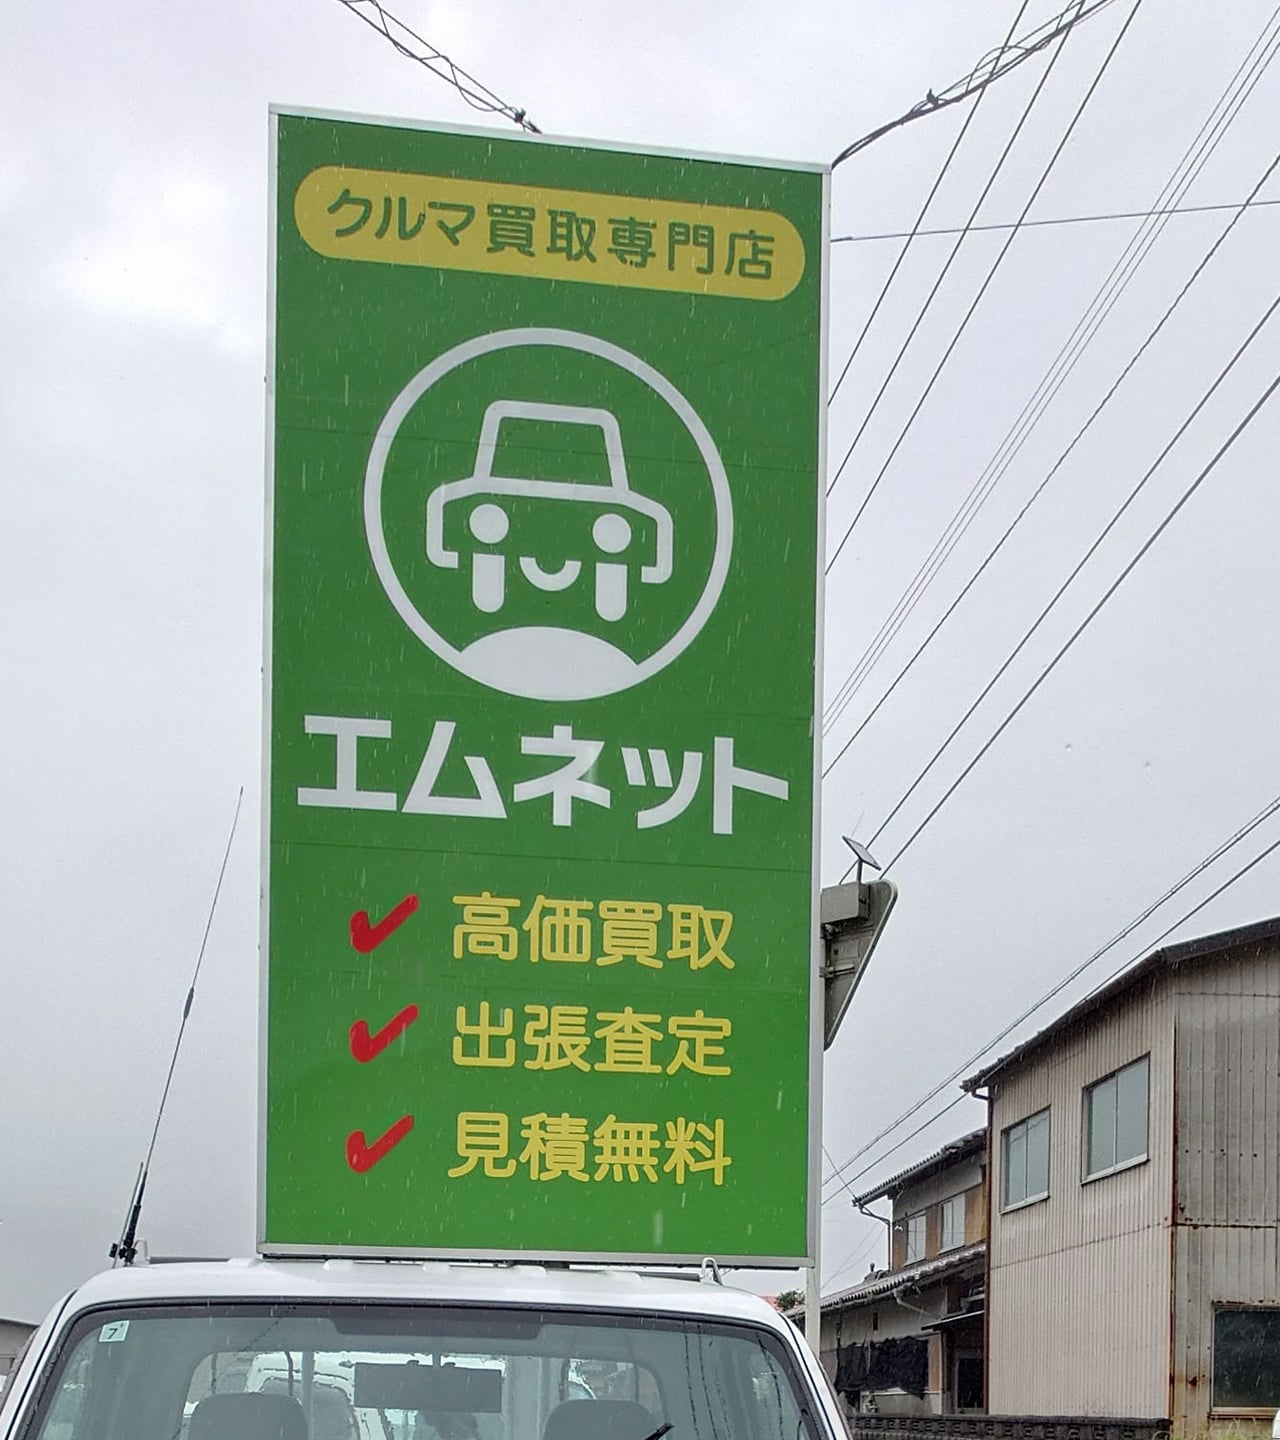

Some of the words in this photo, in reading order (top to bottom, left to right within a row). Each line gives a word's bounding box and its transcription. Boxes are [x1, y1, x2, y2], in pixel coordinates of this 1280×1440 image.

[327, 187, 776, 281] クルマ買取専門店
[297, 714, 790, 835] エムネット
[451, 890, 736, 970] 高価買取
[452, 1001, 733, 1077] 出張査定
[447, 1111, 733, 1186] 見積無料
